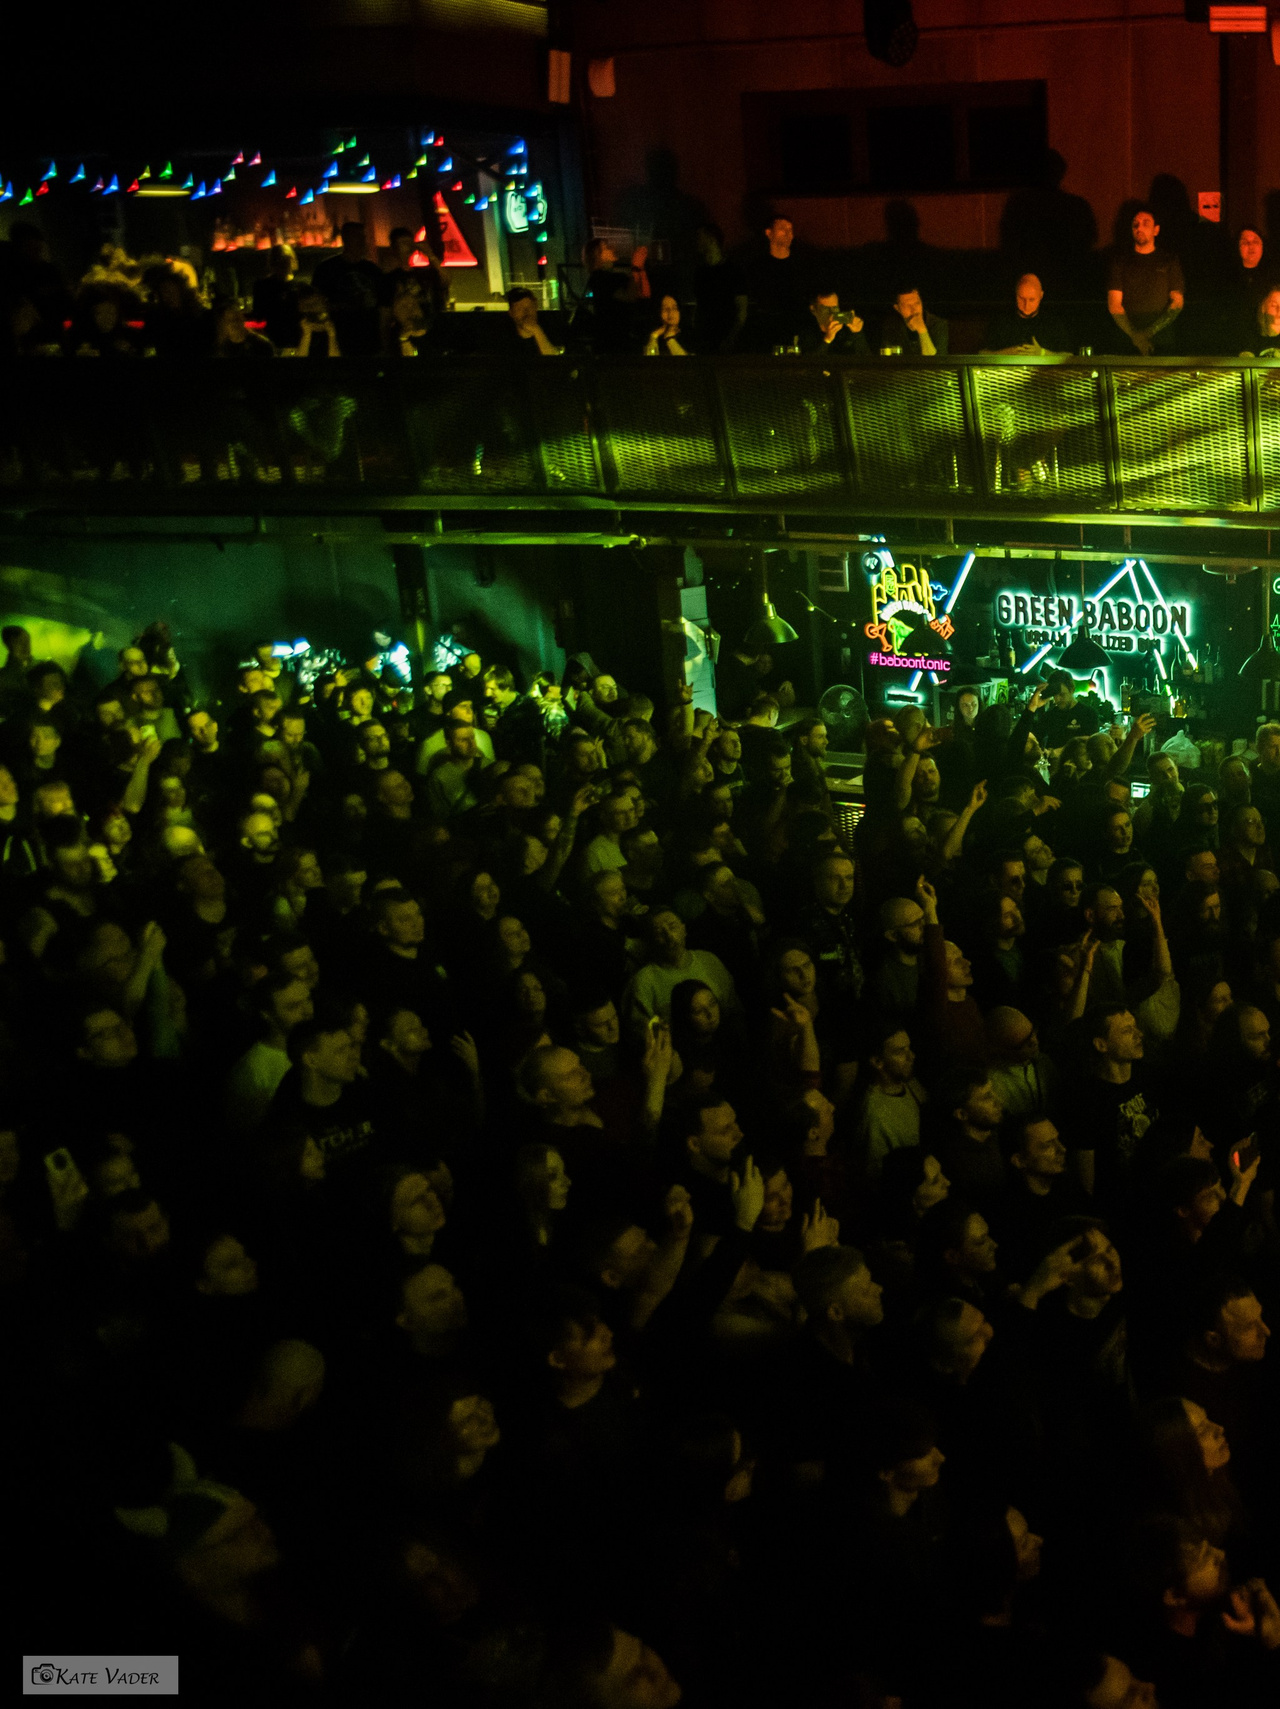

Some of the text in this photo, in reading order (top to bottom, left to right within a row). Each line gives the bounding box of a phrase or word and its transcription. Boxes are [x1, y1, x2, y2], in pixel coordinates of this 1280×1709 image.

[998, 594, 1187, 636] GREEN BABOON
[869, 651, 951, 671] #baboontonic
